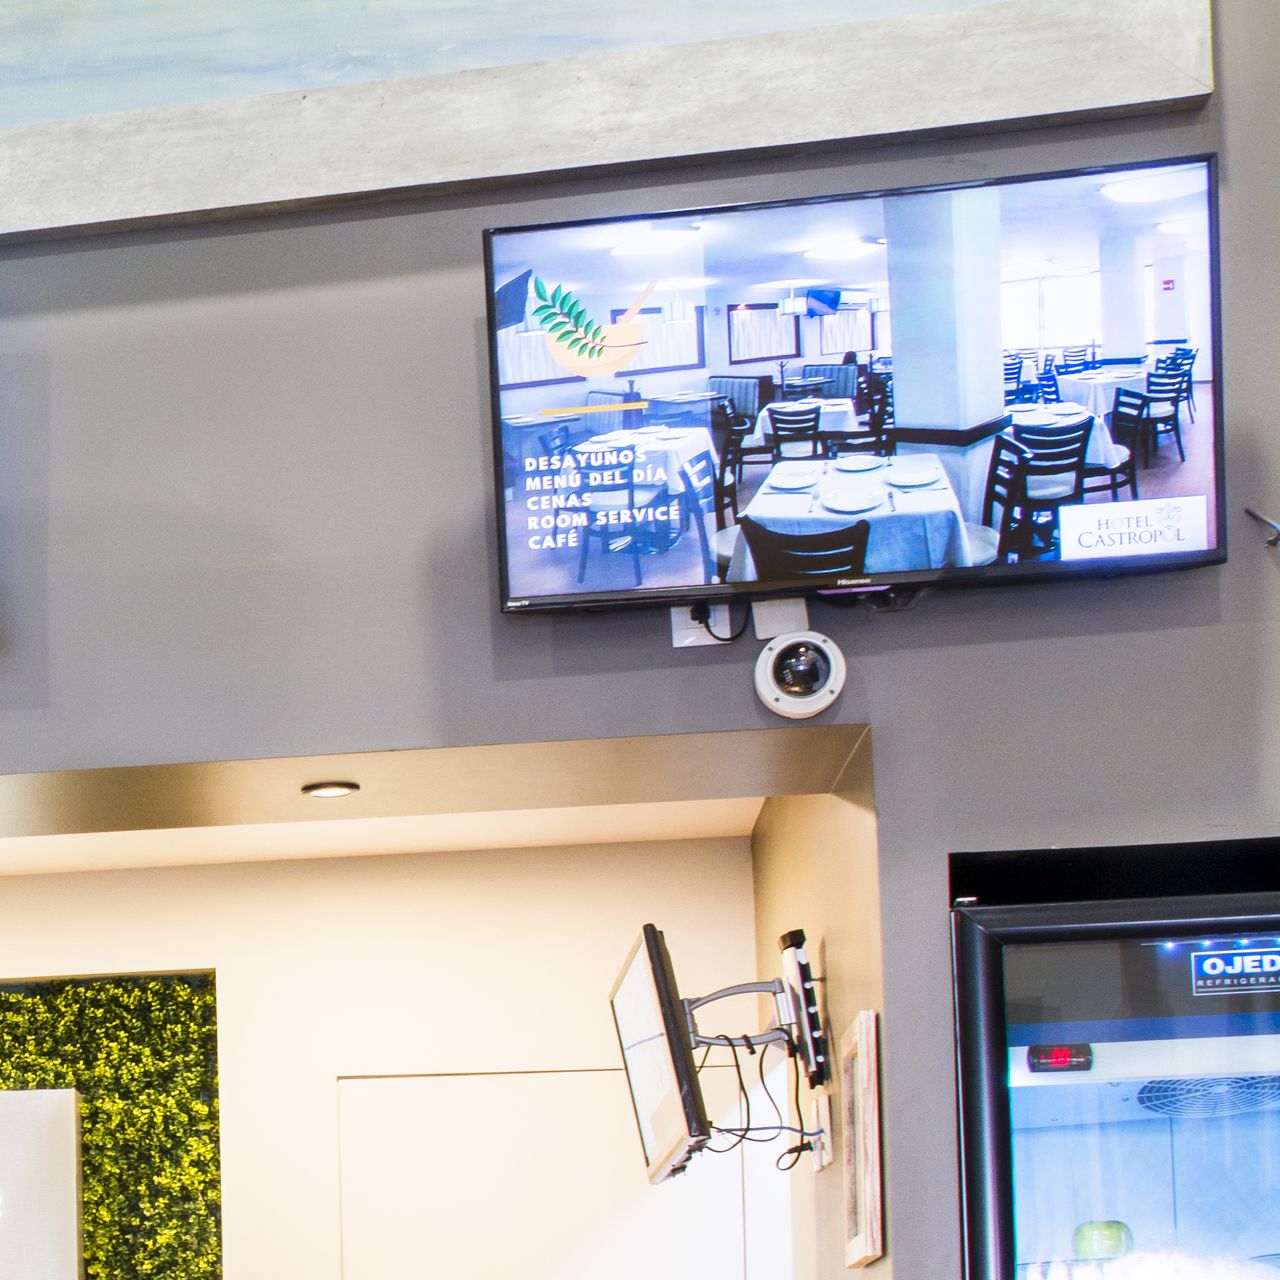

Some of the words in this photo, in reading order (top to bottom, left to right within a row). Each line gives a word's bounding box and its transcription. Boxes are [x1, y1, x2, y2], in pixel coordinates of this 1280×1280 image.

[524, 450, 647, 472] DESAYUNOS
[525, 469, 582, 491] MENÚ
[589, 470, 629, 487] DEL
[632, 464, 668, 483] DÍA
[526, 492, 593, 511] CENAS
[527, 512, 588, 530] ROOM
[595, 505, 681, 526] SERVICE
[1097, 515, 1153, 531] HOTEL
[528, 529, 578, 550] CAFÉ
[1077, 528, 1186, 549] CASTROPOL
[1196, 976, 1280, 987] REFRIGERA
